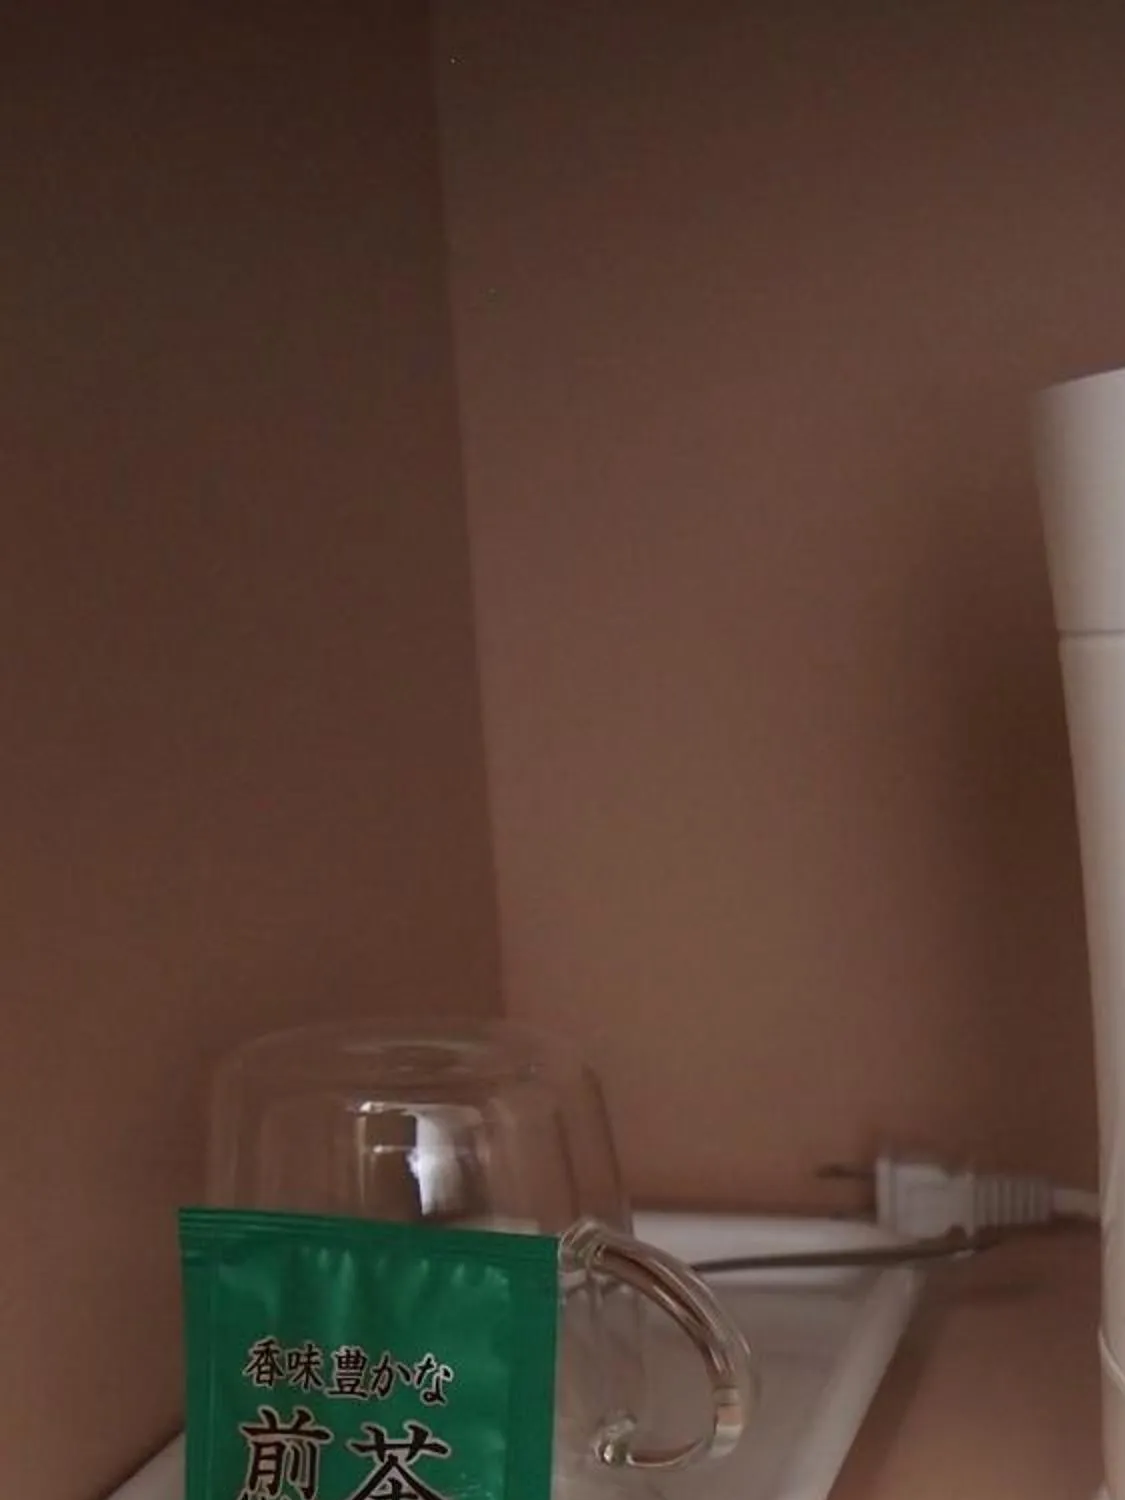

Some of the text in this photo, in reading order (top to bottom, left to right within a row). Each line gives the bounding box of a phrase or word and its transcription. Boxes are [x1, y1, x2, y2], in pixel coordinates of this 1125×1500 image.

[243, 1338, 454, 1406] 香味豊かな
